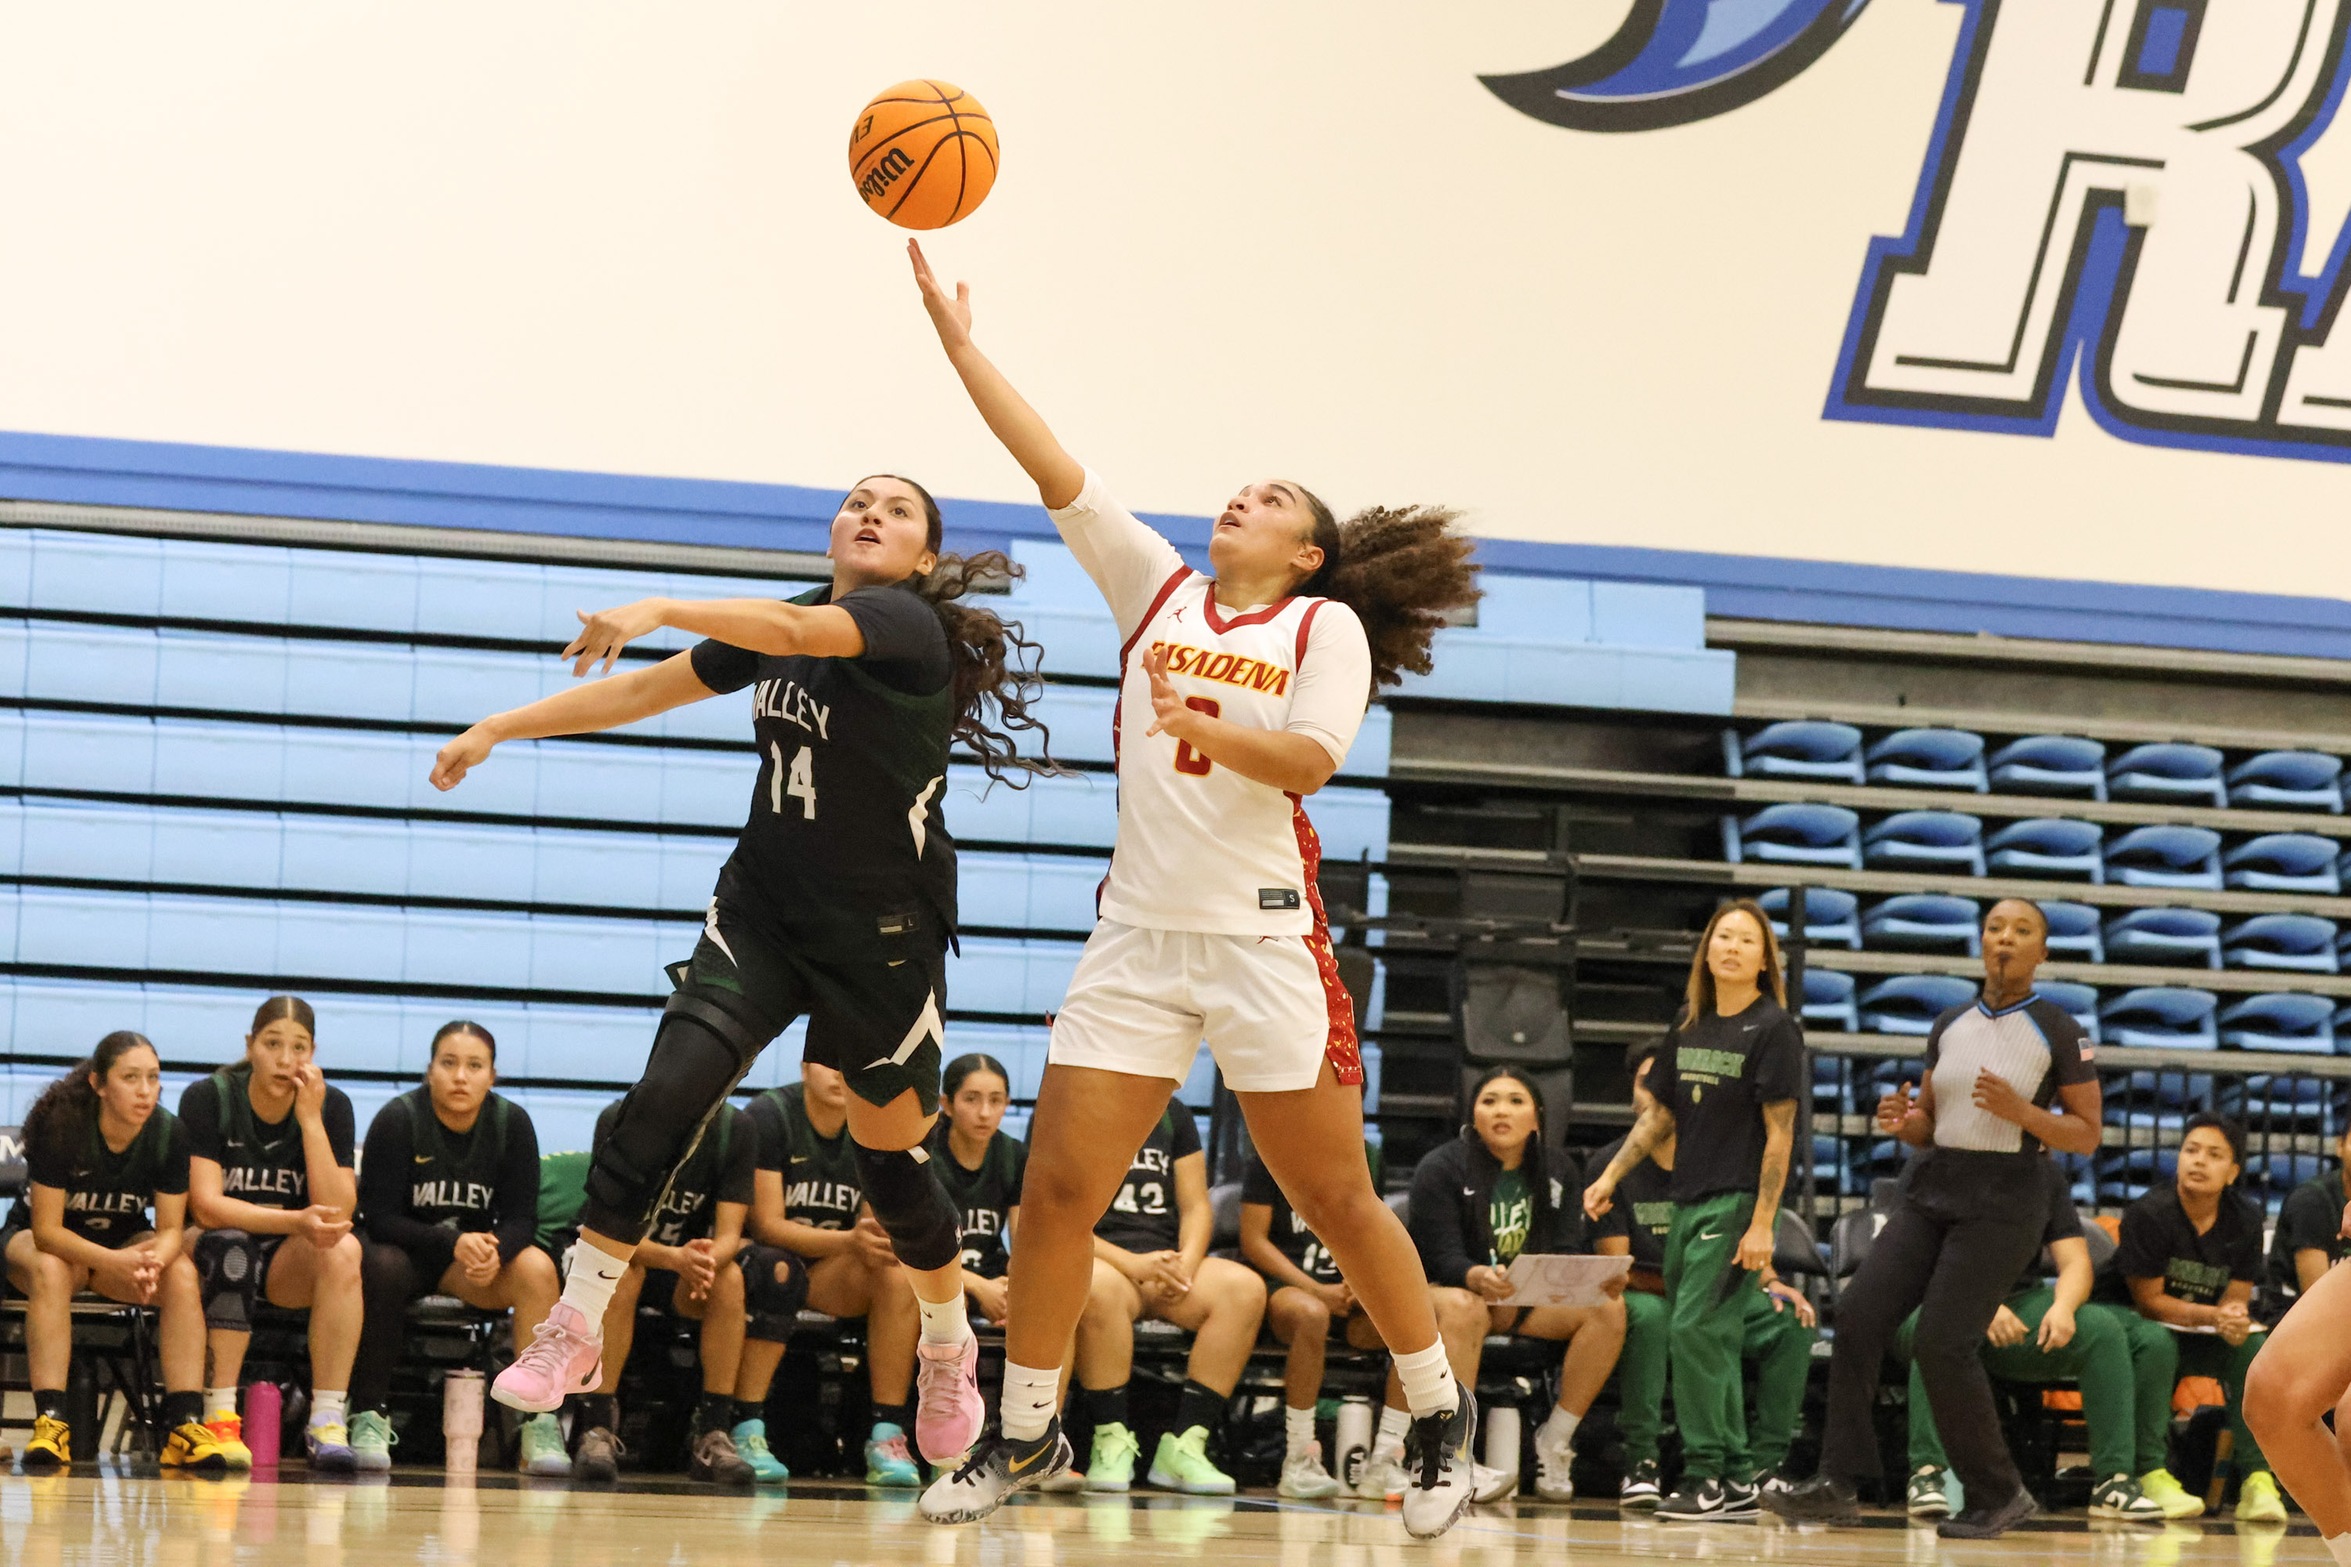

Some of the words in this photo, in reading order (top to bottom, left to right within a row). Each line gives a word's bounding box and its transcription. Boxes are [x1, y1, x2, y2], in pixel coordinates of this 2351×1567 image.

[1821, 0, 2351, 464] R
[770, 740, 817, 820] 14
[223, 1166, 305, 1196] VALLEY
[413, 1180, 494, 1210] VALLEY
[785, 1181, 861, 1213] VALLEY
[1113, 1182, 1167, 1215] 42
